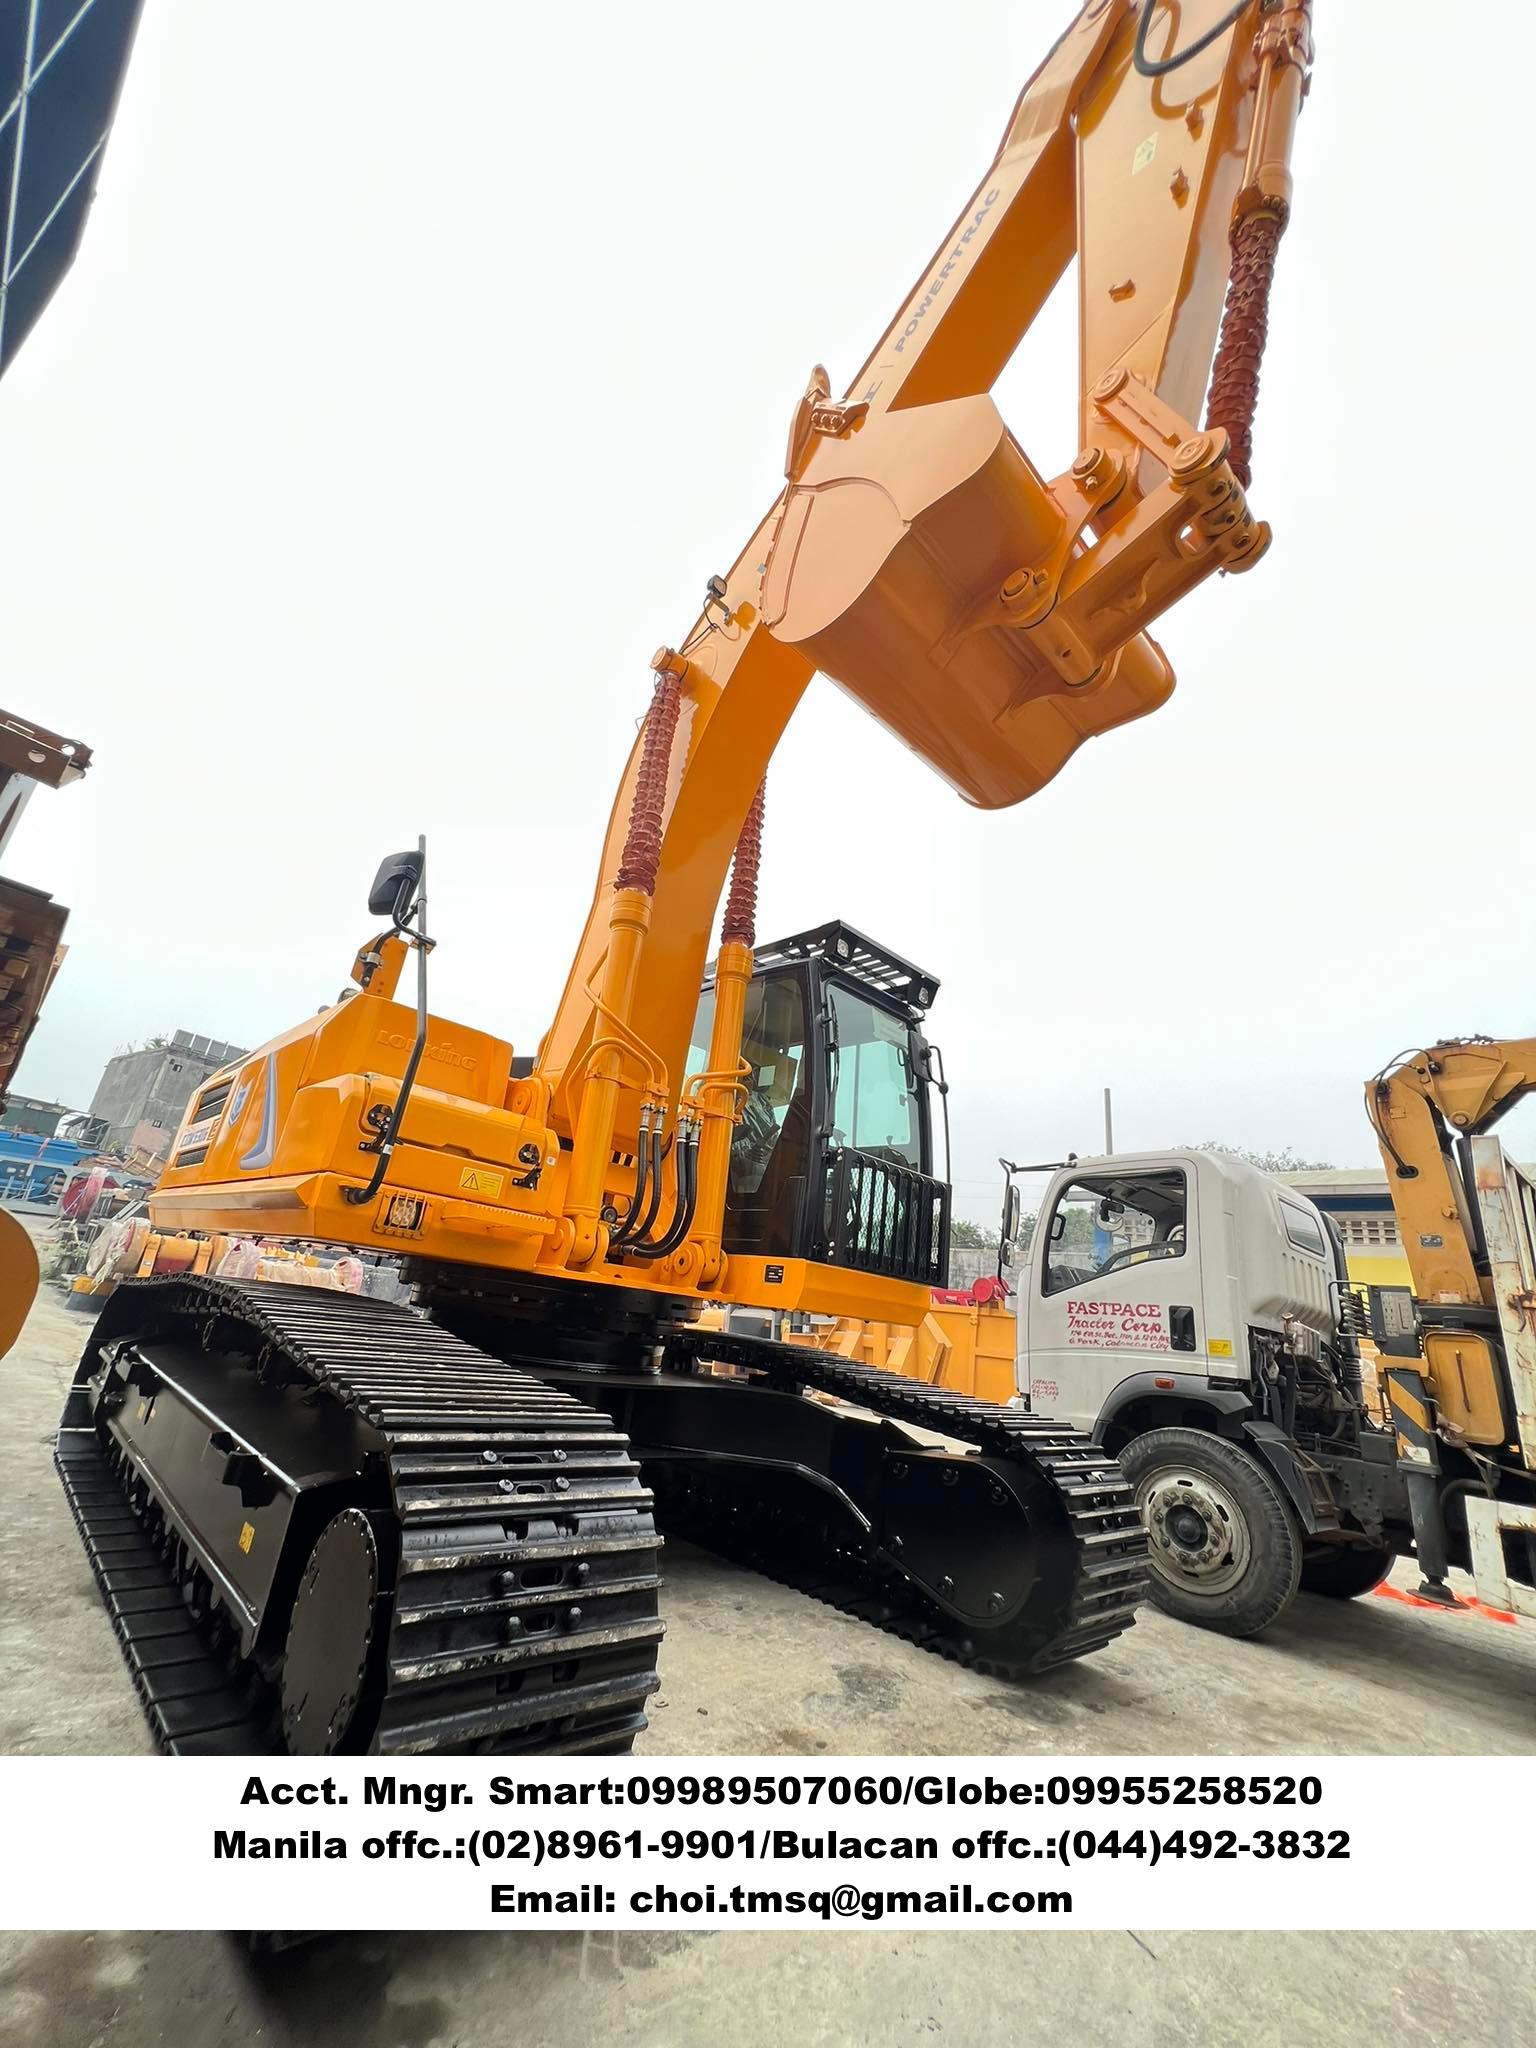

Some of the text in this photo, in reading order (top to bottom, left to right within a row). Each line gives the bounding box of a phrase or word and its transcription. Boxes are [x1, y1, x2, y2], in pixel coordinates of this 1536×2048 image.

[894, 189, 1000, 353] POWERTRAC
[1067, 1301, 1162, 1318] FASTPACE
[1067, 1316, 1167, 1334] Tractor Corp.
